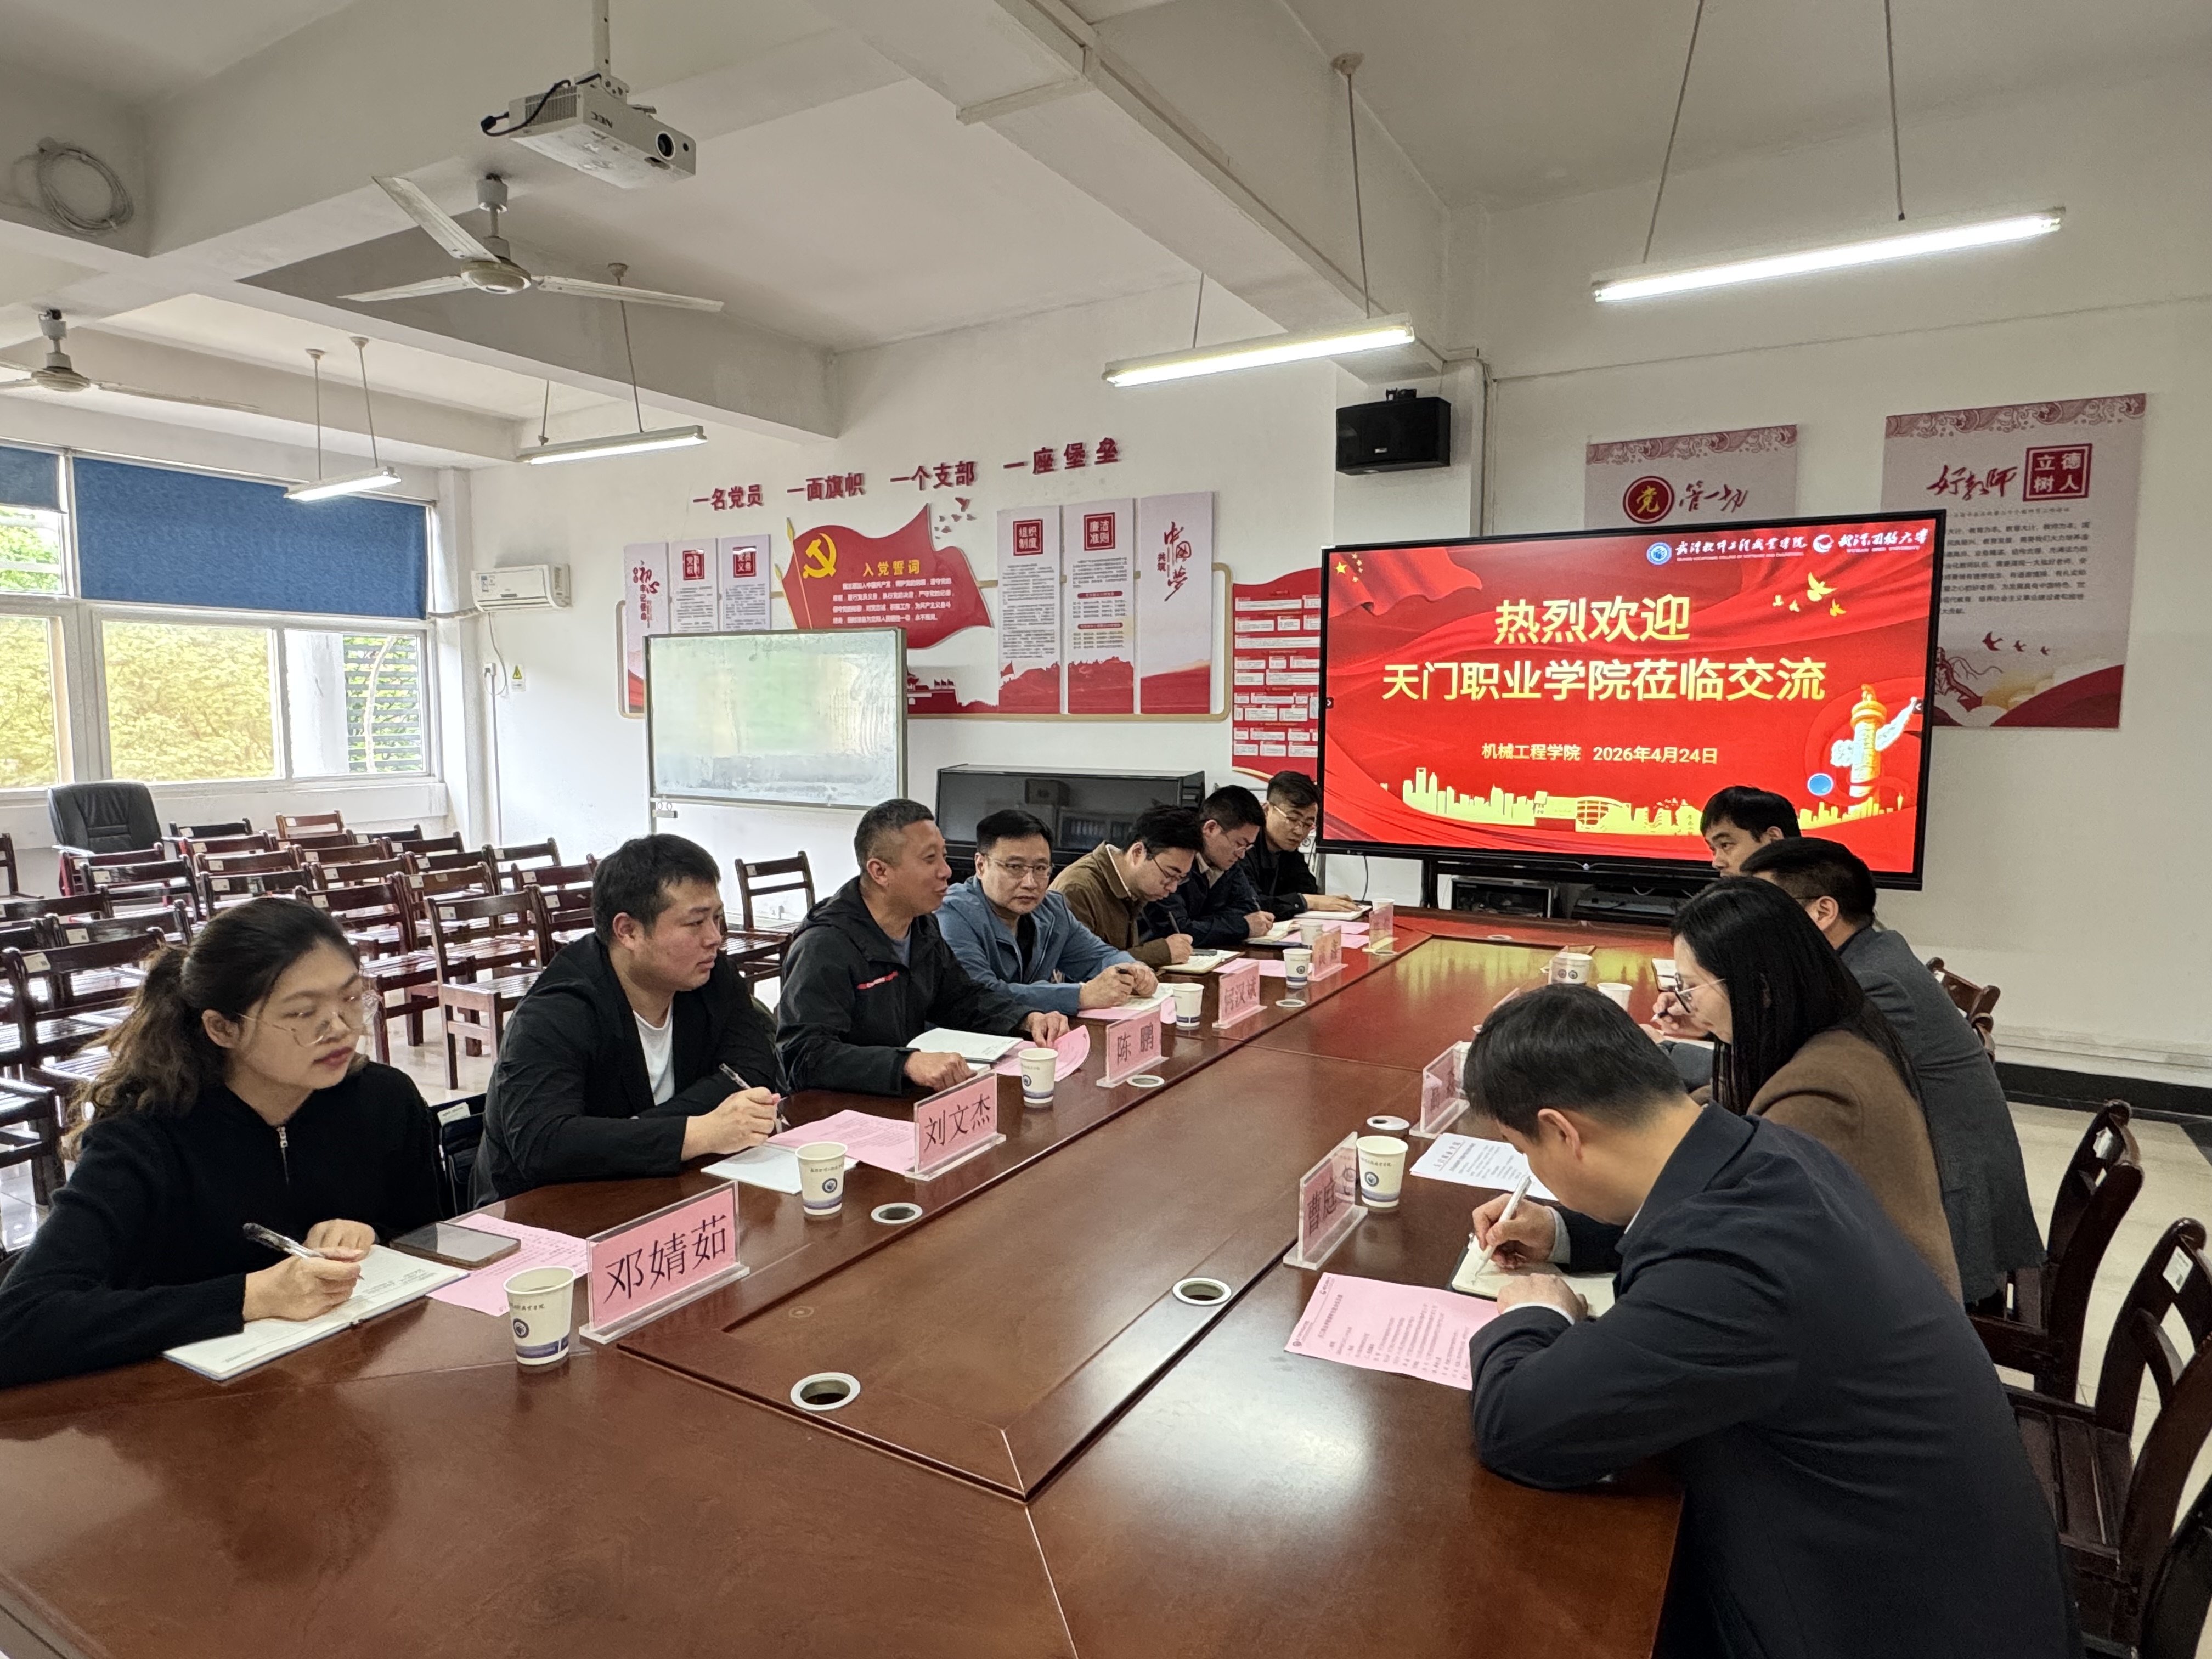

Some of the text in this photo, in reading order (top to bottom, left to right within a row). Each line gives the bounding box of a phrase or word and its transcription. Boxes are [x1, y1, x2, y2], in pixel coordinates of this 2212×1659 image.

[693, 437, 1119, 511] 一名党员 一面旗帜 一个支部 一座堡垒
[2033, 474, 2080, 493] 树人
[2034, 452, 2082, 471] 立德
[862, 560, 920, 577] 入党誓词
[1494, 594, 1690, 645] 热烈欢迎
[1381, 656, 1827, 702] 天门职业学院莅临交流
[1481, 742, 1718, 765] 机械工程学院 2026年4月24日
[924, 1093, 992, 1153] 刘文杰
[603, 1214, 726, 1304] 邓婧茹
